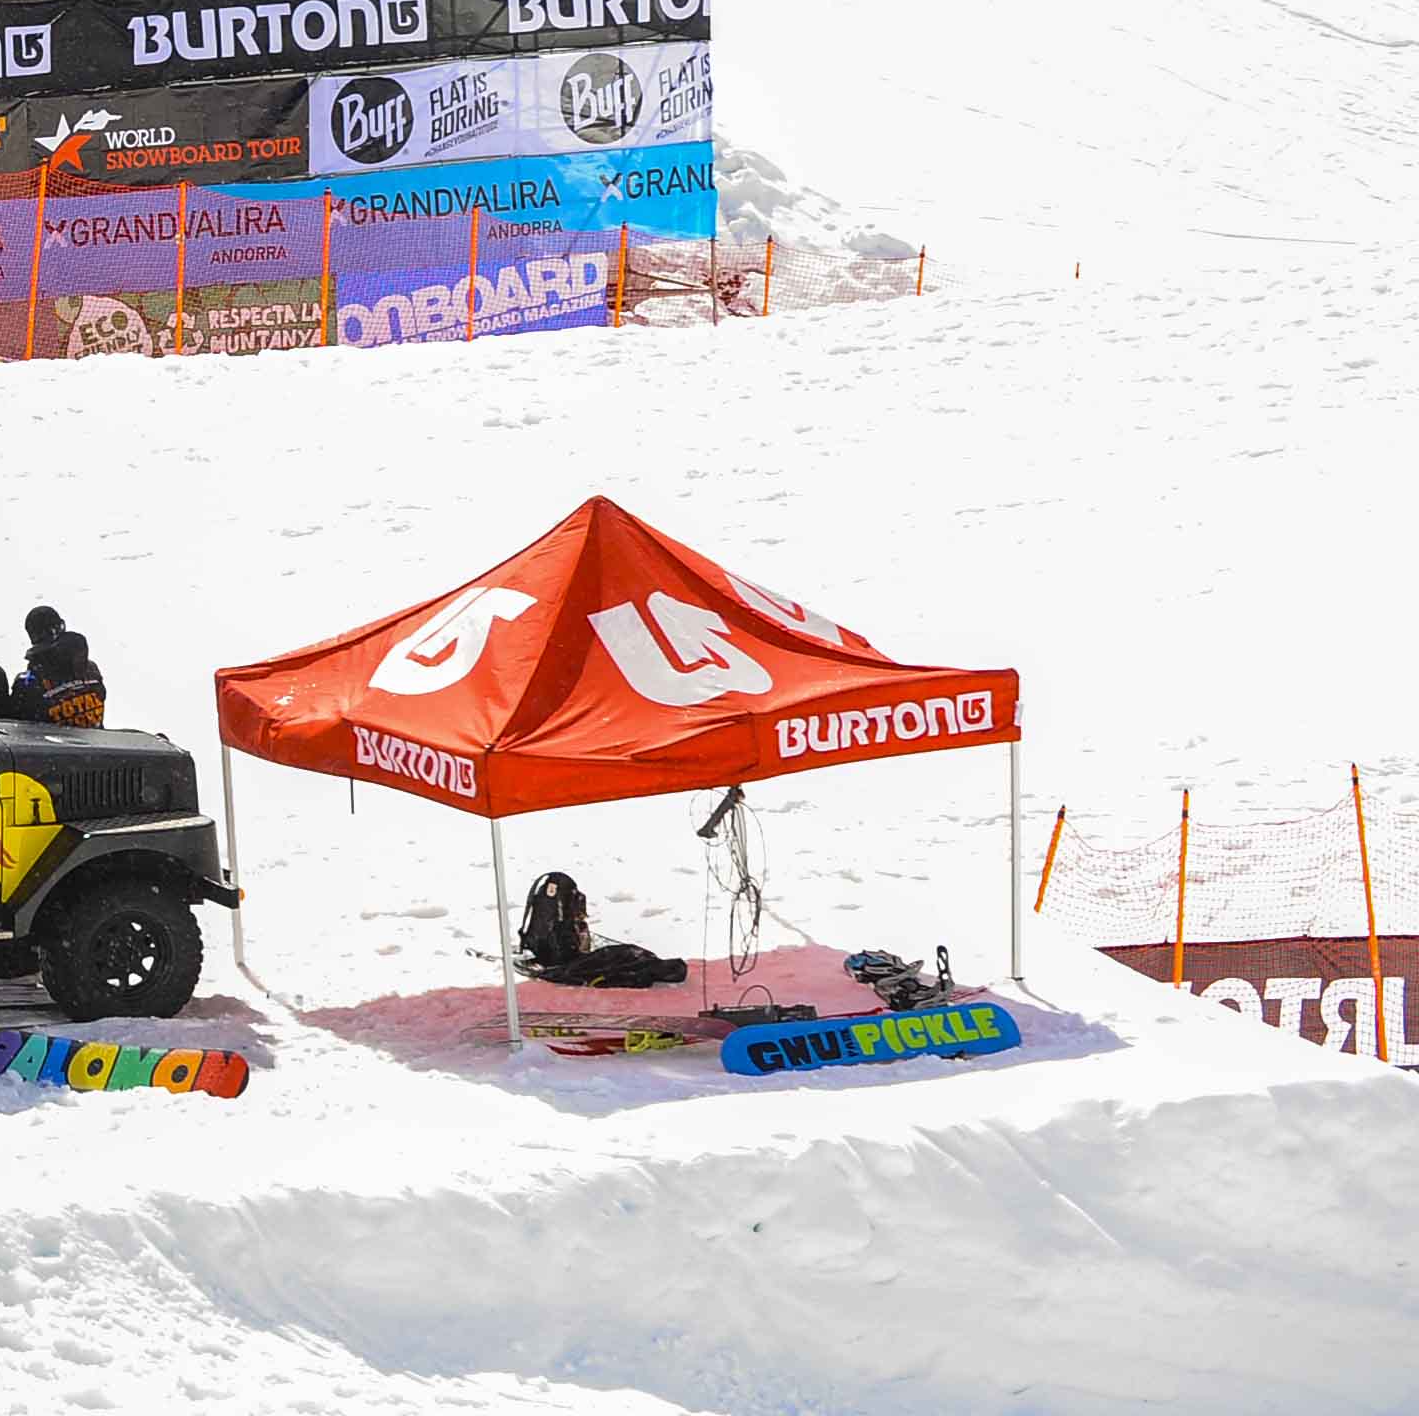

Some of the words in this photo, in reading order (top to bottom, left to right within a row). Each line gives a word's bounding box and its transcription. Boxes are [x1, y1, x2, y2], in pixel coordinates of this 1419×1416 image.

[429, 72, 469, 117] FLAT
[472, 71, 488, 96] IS
[658, 55, 697, 97] FLAT
[104, 127, 176, 150] WORLD
[106, 141, 244, 171] SNOWBOARD
[246, 136, 302, 160] TOUR
[349, 178, 562, 226] GRANDVALIRA
[71, 203, 286, 248] GRANDVALIRA
[486, 219, 564, 240] ANDORRA
[209, 244, 288, 266] ANDORRA
[208, 305, 300, 329] RESPECTA
[300, 302, 323, 324] LA
[209, 327, 323, 356] MUNTANYA
[774, 696, 960, 758] BURTON
[353, 726, 457, 793] BURTON
[746, 1030, 844, 1072] GNU
[851, 1007, 1001, 1057] PICKLE
